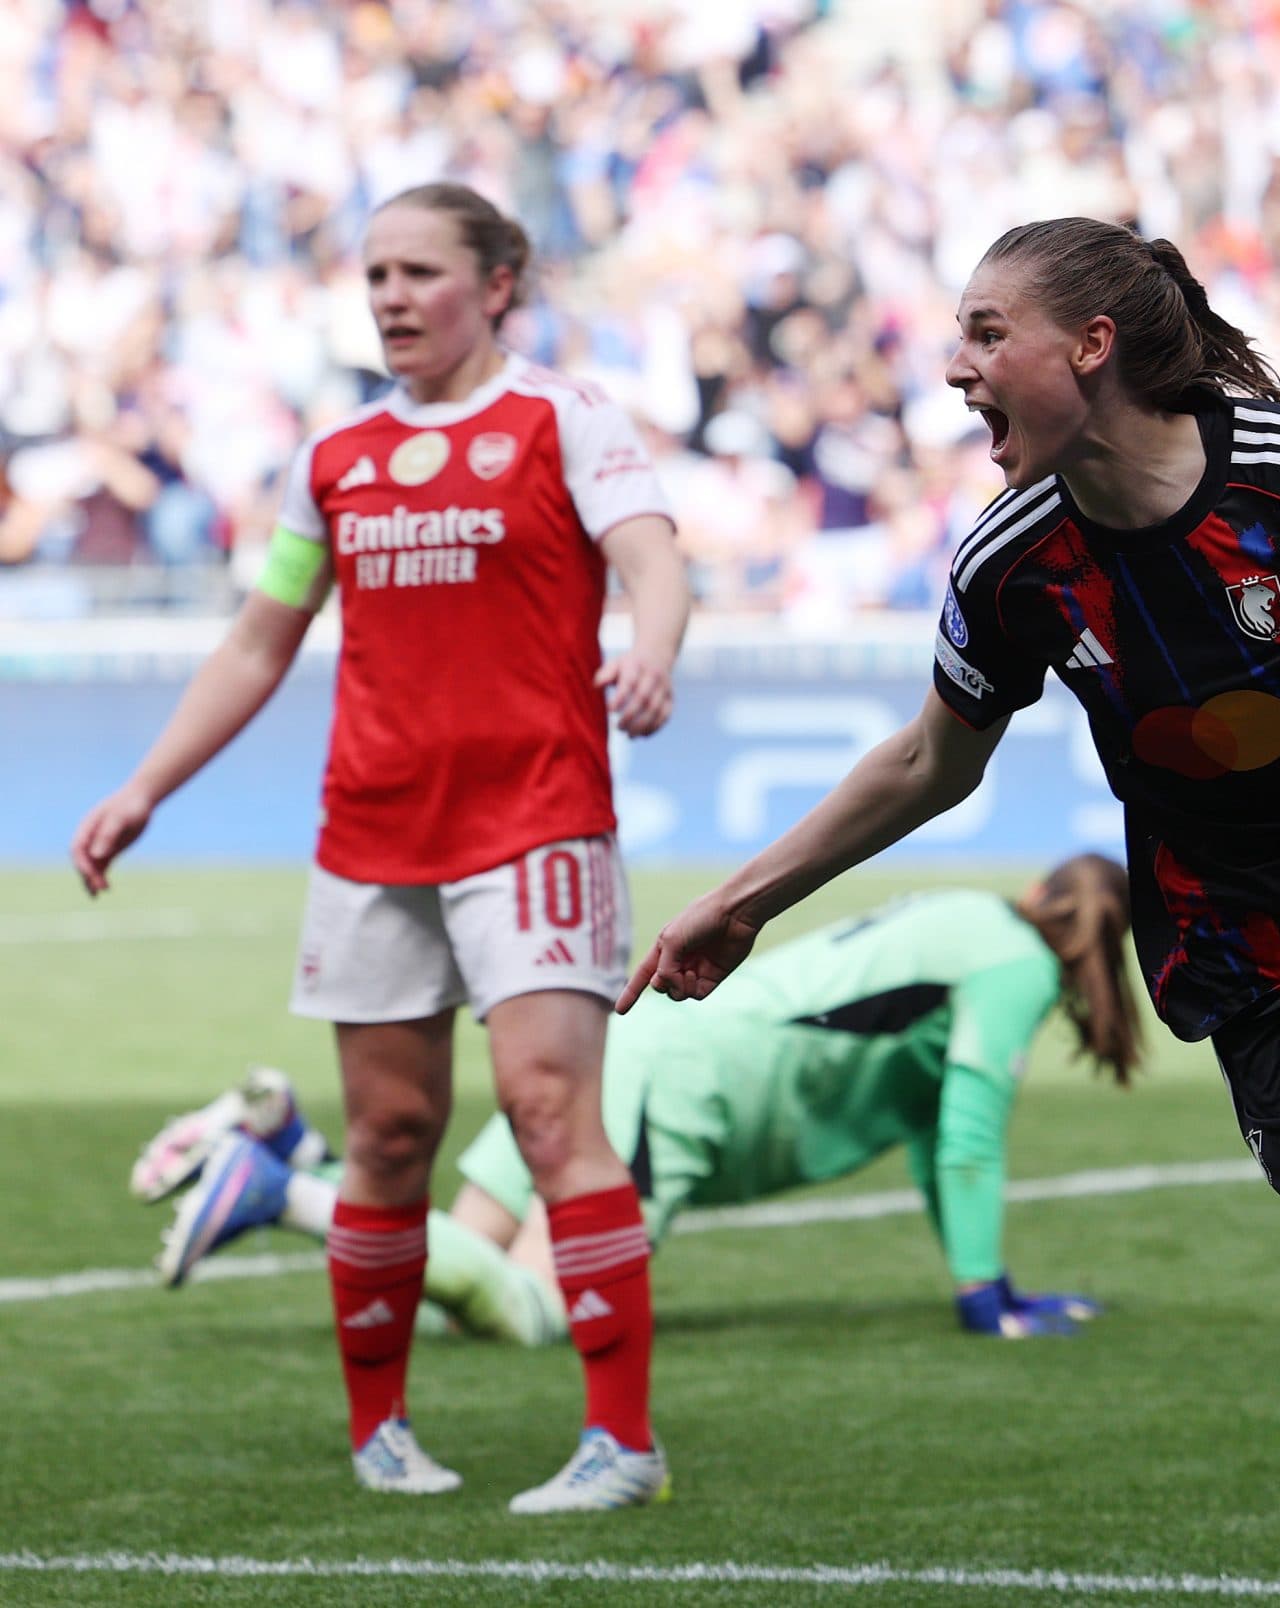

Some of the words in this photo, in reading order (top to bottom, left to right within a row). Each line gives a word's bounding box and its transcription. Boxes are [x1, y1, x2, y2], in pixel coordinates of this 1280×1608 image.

[338, 505, 506, 555] Emirates
[356, 552, 390, 590] FLY
[393, 546, 477, 587] BETTER
[513, 848, 584, 933] 10
